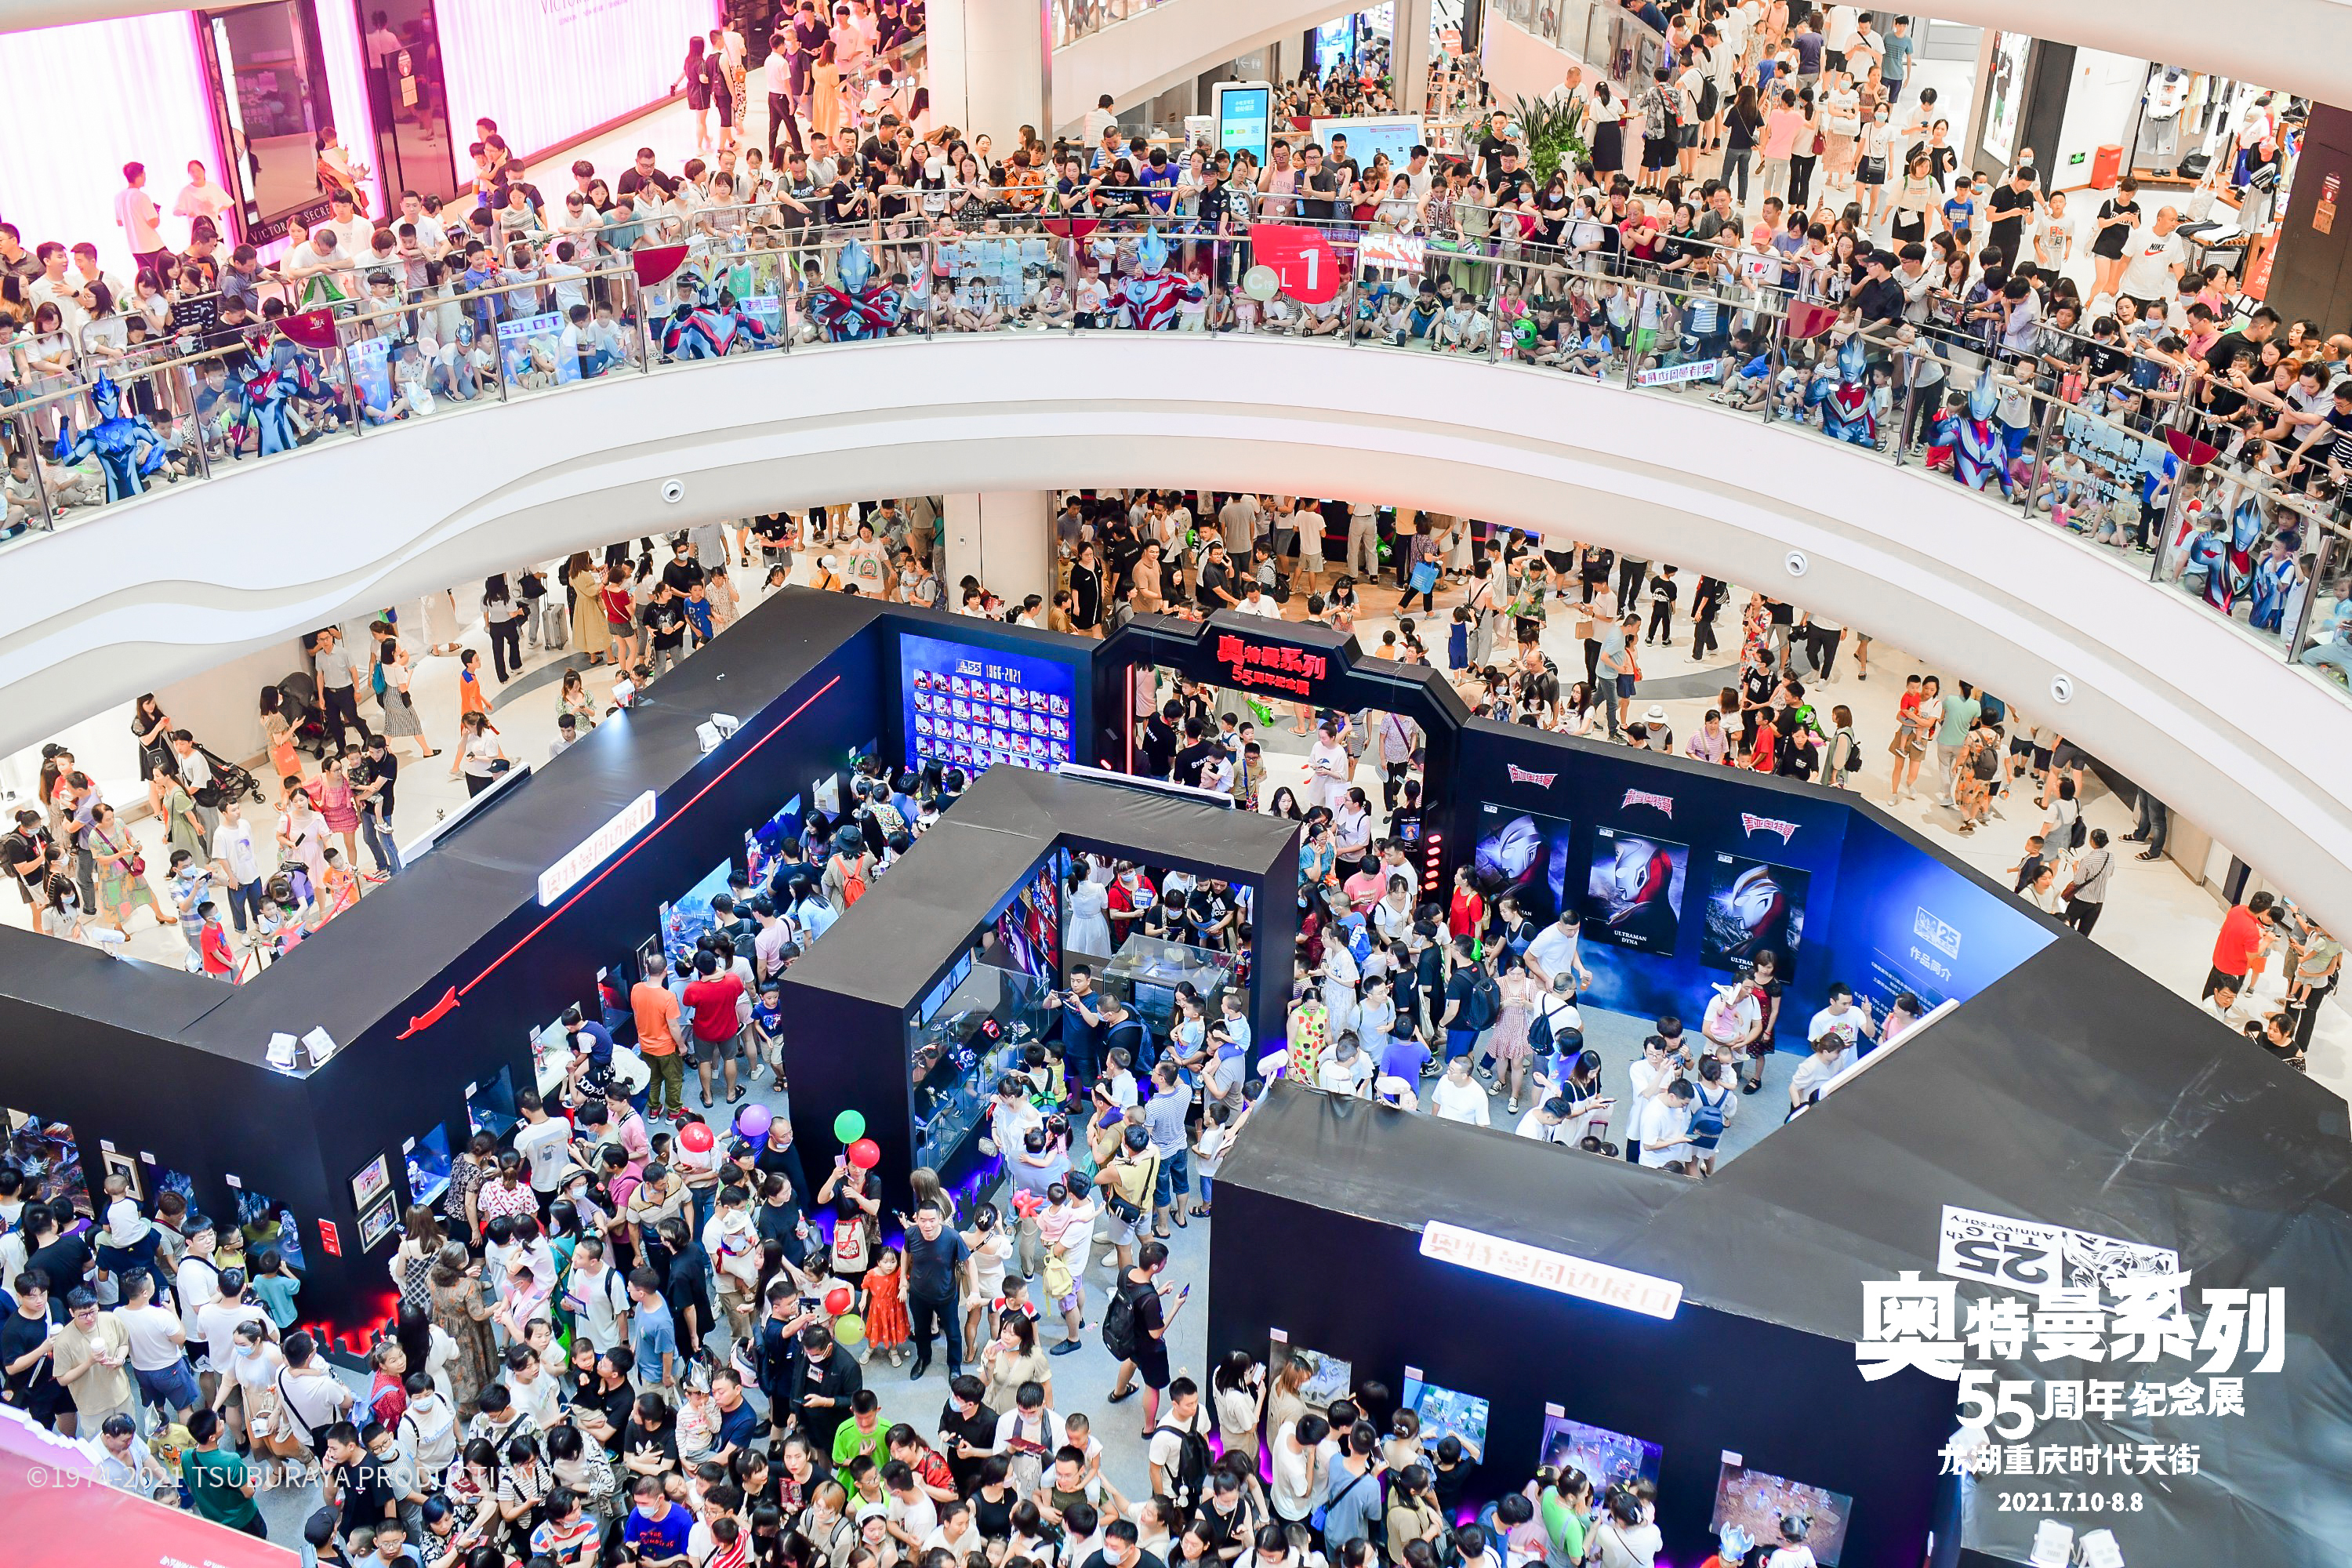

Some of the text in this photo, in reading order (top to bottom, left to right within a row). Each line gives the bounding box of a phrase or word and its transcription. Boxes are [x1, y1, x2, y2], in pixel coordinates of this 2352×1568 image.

[250, 205, 329, 242] VICTOR SECRE
[985, 664, 1022, 684] 1966-2021
[1613, 930, 1646, 942] ULTRAMAN
[1910, 945, 1952, 982] 作品简介
[1951, 1214, 2055, 1240] Anniversary
